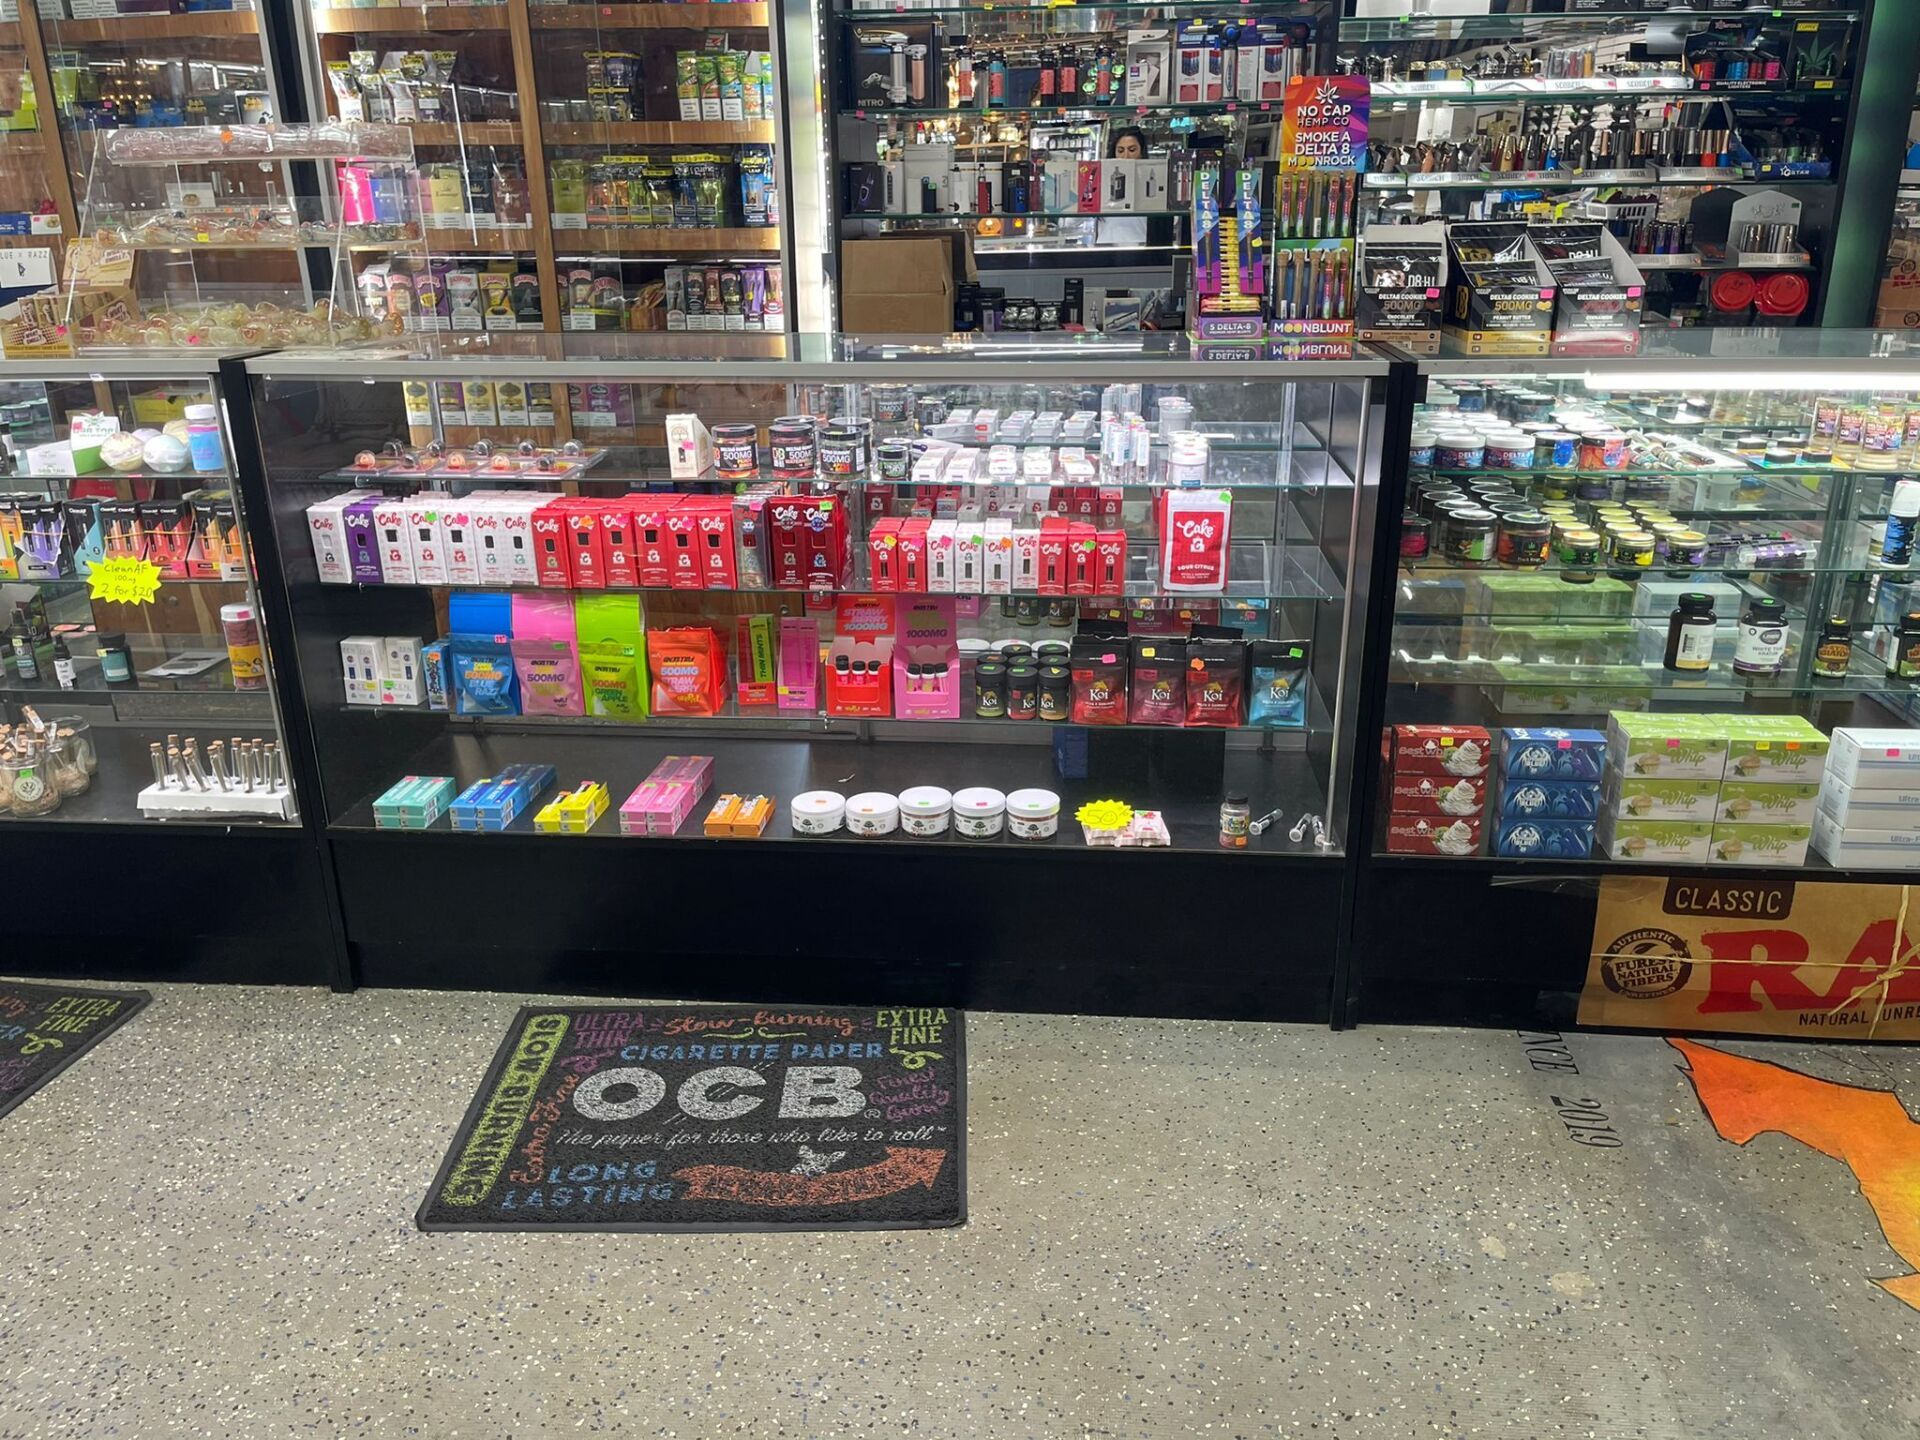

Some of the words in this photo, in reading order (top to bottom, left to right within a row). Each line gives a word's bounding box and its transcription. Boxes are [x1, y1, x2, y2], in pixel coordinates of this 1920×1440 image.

[857, 98, 884, 107] NITRO
[1297, 105, 1319, 117] NO
[1322, 104, 1352, 117] CAP
[1296, 117, 1329, 127] HEMP
[1333, 116, 1350, 126] CO
[1295, 132, 1338, 144] SMOKE
[1341, 131, 1351, 142] A
[1295, 143, 1338, 155] DELTA
[1341, 142, 1351, 154] 8
[28, 251, 48, 259] RAZZ
[1383, 300, 1421, 310] 500MG
[1494, 300, 1533, 311] 500MG
[1217, 323, 1252, 331] DELTA-8
[723, 450, 752, 460] 500MG
[822, 454, 851, 463] 500MG
[344, 513, 370, 528] Cake
[375, 511, 403, 527] Cake
[771, 506, 799, 521] Cake
[802, 506, 832, 521] Cake
[310, 518, 334, 531] Cake
[473, 515, 498, 529] Cake
[502, 516, 528, 530] Cake
[533, 517, 561, 534] Cake
[698, 514, 726, 533] Cake
[1176, 518, 1214, 538] Cake
[1015, 535, 1039, 548] Cake
[1040, 543, 1063, 555] Cake
[1096, 543, 1120, 556] Cake
[101, 584, 110, 594] 2
[114, 584, 129, 595] for
[131, 585, 154, 598] $20
[843, 609, 885, 617] STRAW
[851, 615, 889, 624] BERRY
[843, 623, 889, 631] 1000MG
[906, 629, 948, 638] 1000MG
[756, 633, 765, 658] MINTS
[527, 674, 565, 682] 500MG
[660, 666, 699, 676] 500MG
[475, 687, 499, 696] RAZZ
[592, 680, 627, 689] 500MG
[1089, 687, 1109, 701] Koi
[1151, 688, 1171, 700] Koi
[1203, 689, 1223, 703] Koi
[1269, 686, 1289, 699] Koi
[981, 694, 998, 707] Koi
[1669, 748, 1707, 766] Whip
[1770, 749, 1808, 767] Whip
[1660, 790, 1697, 809] Whip
[1759, 792, 1797, 811] Whip
[1654, 831, 1691, 851] Whip
[1751, 833, 1788, 853] Whip
[1675, 886, 1784, 914] CLASSIC
[1611, 930, 1677, 953] AUTHENTIC
[1614, 952, 1677, 972] PUREST
[1616, 964, 1678, 981] NATURAL
[1621, 973, 1675, 989] FIBERS
[44, 996, 122, 1017] EXTRA
[34, 1014, 100, 1034] FINE
[573, 1013, 646, 1031] ULTRA
[876, 1008, 949, 1029] EXTRA
[1798, 1010, 1871, 1027] NATURAL
[575, 1030, 634, 1049] THIN
[890, 1027, 943, 1046] FINE
[620, 1043, 782, 1062] CIGARETTE
[791, 1042, 884, 1060] PAPER
[573, 1066, 867, 1121] OCB
[593, 1132, 664, 1150] paper
[664, 1127, 700, 1151] for
[707, 1127, 764, 1144] those
[768, 1130, 812, 1144] who
[817, 1126, 858, 1143] like
[863, 1127, 884, 1142] to
[547, 1160, 658, 1184] LONG
[500, 1183, 676, 1210] LASTING
